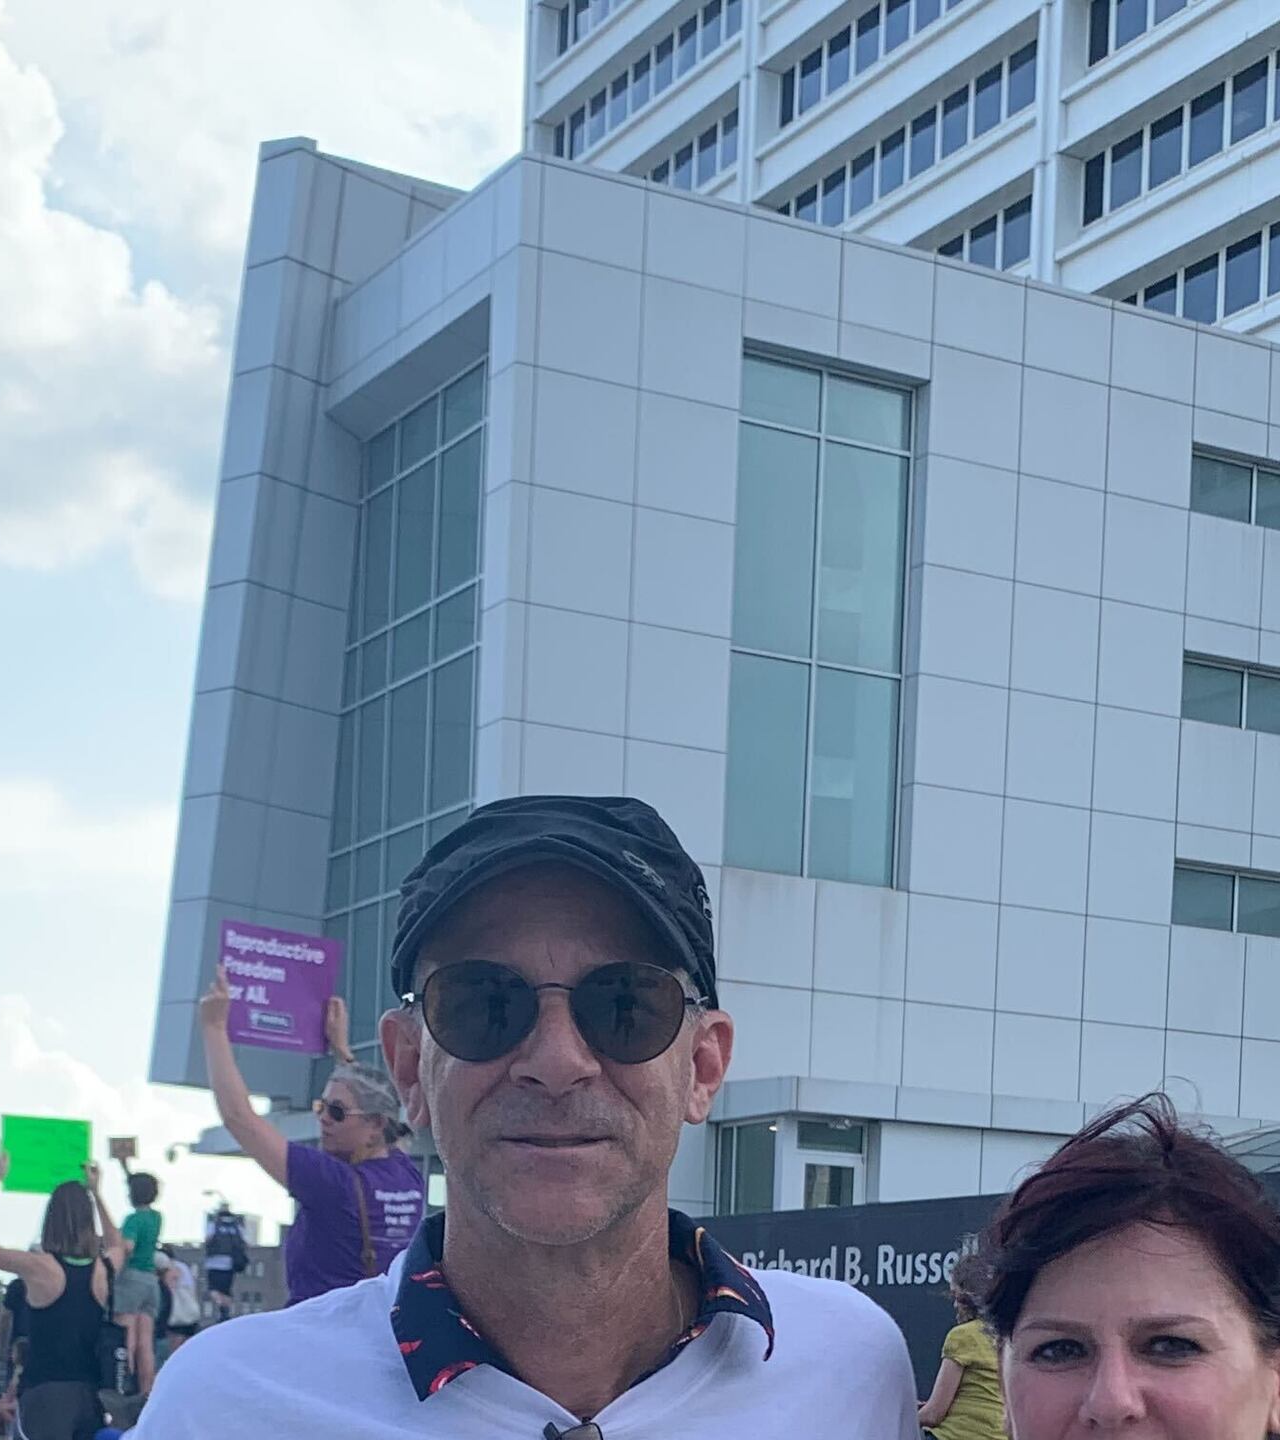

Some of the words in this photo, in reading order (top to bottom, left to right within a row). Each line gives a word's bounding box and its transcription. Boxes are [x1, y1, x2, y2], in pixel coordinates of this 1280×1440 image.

[225, 929, 326, 965] Reproductive
[224, 954, 287, 983] Freedom
[228, 985, 245, 1001] or
[844, 1246, 870, 1287] B.
